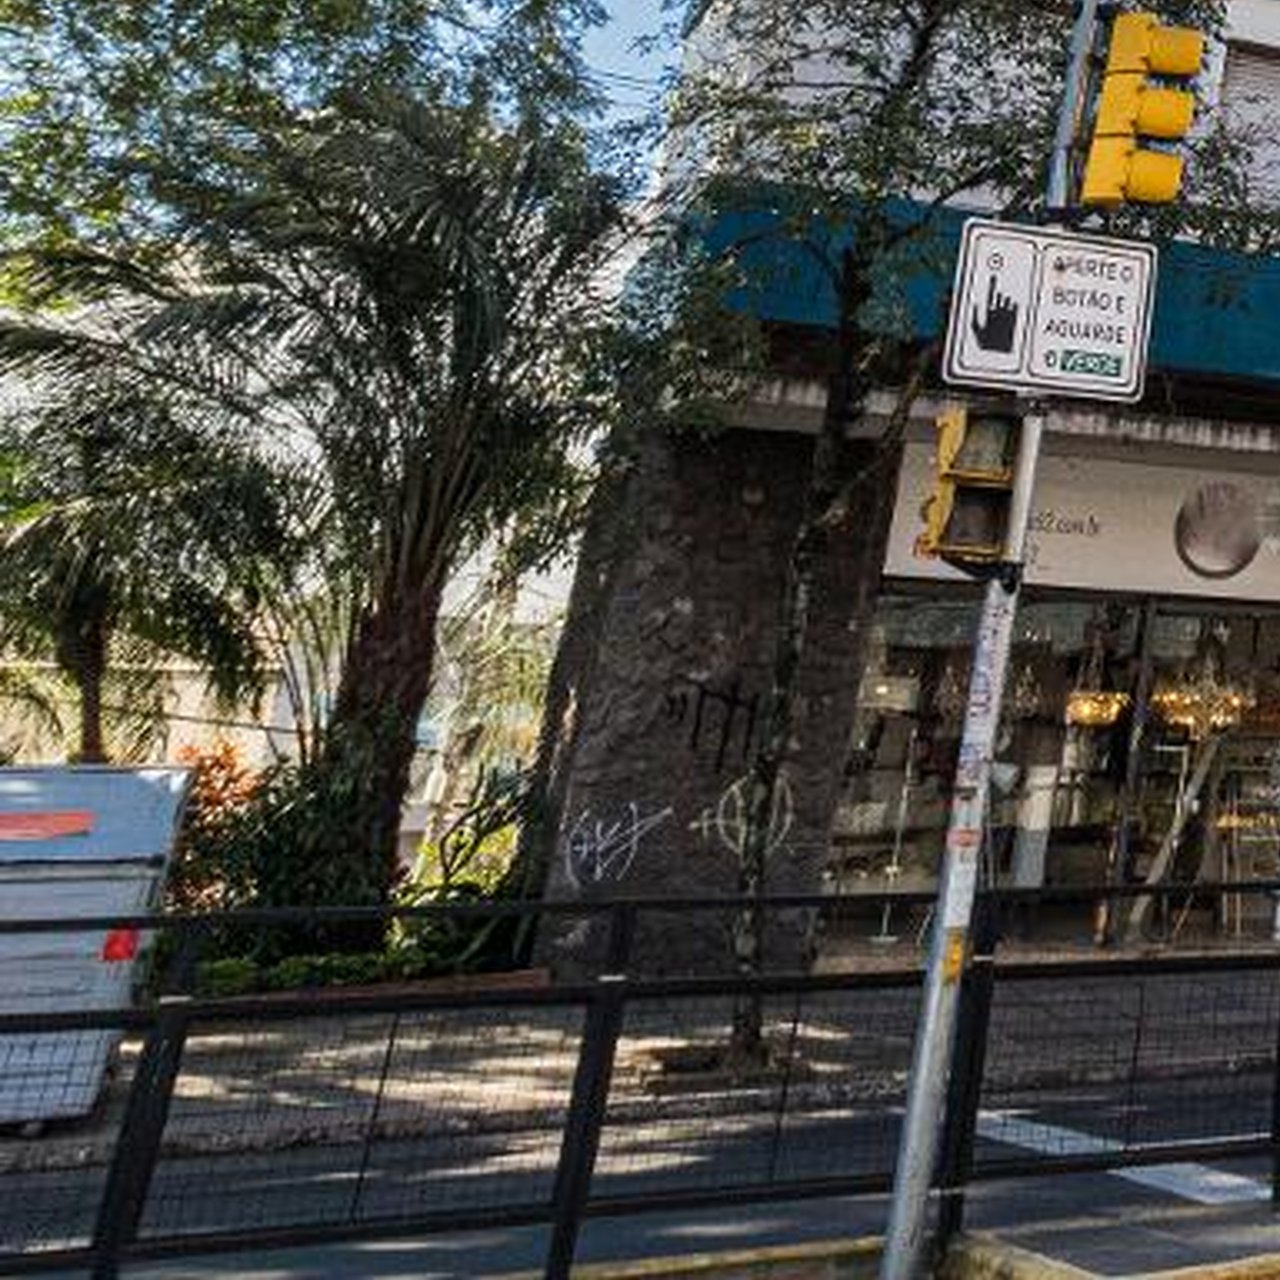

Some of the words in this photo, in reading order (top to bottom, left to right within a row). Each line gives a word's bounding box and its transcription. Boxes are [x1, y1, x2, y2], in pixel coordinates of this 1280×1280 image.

[1120, 265, 1135, 283] O
[1115, 295, 1126, 315] E
[1043, 318, 1126, 345] AGUARDE
[1043, 348, 1058, 368] O
